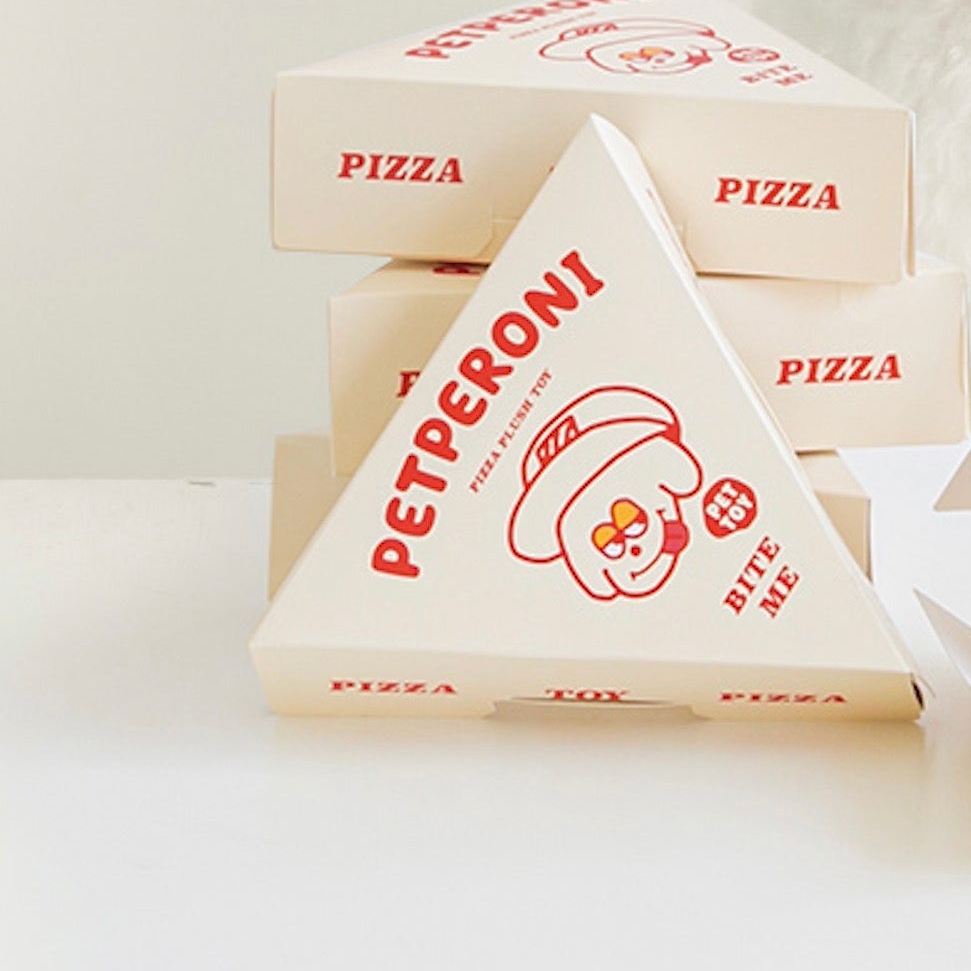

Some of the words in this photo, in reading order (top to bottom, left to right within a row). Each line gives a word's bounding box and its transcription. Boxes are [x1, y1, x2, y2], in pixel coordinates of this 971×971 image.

[339, 153, 462, 184] PIZZA
[715, 178, 839, 210] PIZZA
[777, 355, 900, 385] PIZZA
[370, 250, 606, 579] PETPERONI
[469, 450, 501, 493] PIZZA
[496, 395, 535, 450] PLUSH
[705, 482, 739, 520] PET
[718, 493, 753, 530] TOY
[723, 536, 781, 615] BITE
[759, 565, 800, 619] ME
[330, 680, 456, 694] PIZZA
[546, 689, 629, 702] TOY
[719, 693, 847, 703] PIZZA
